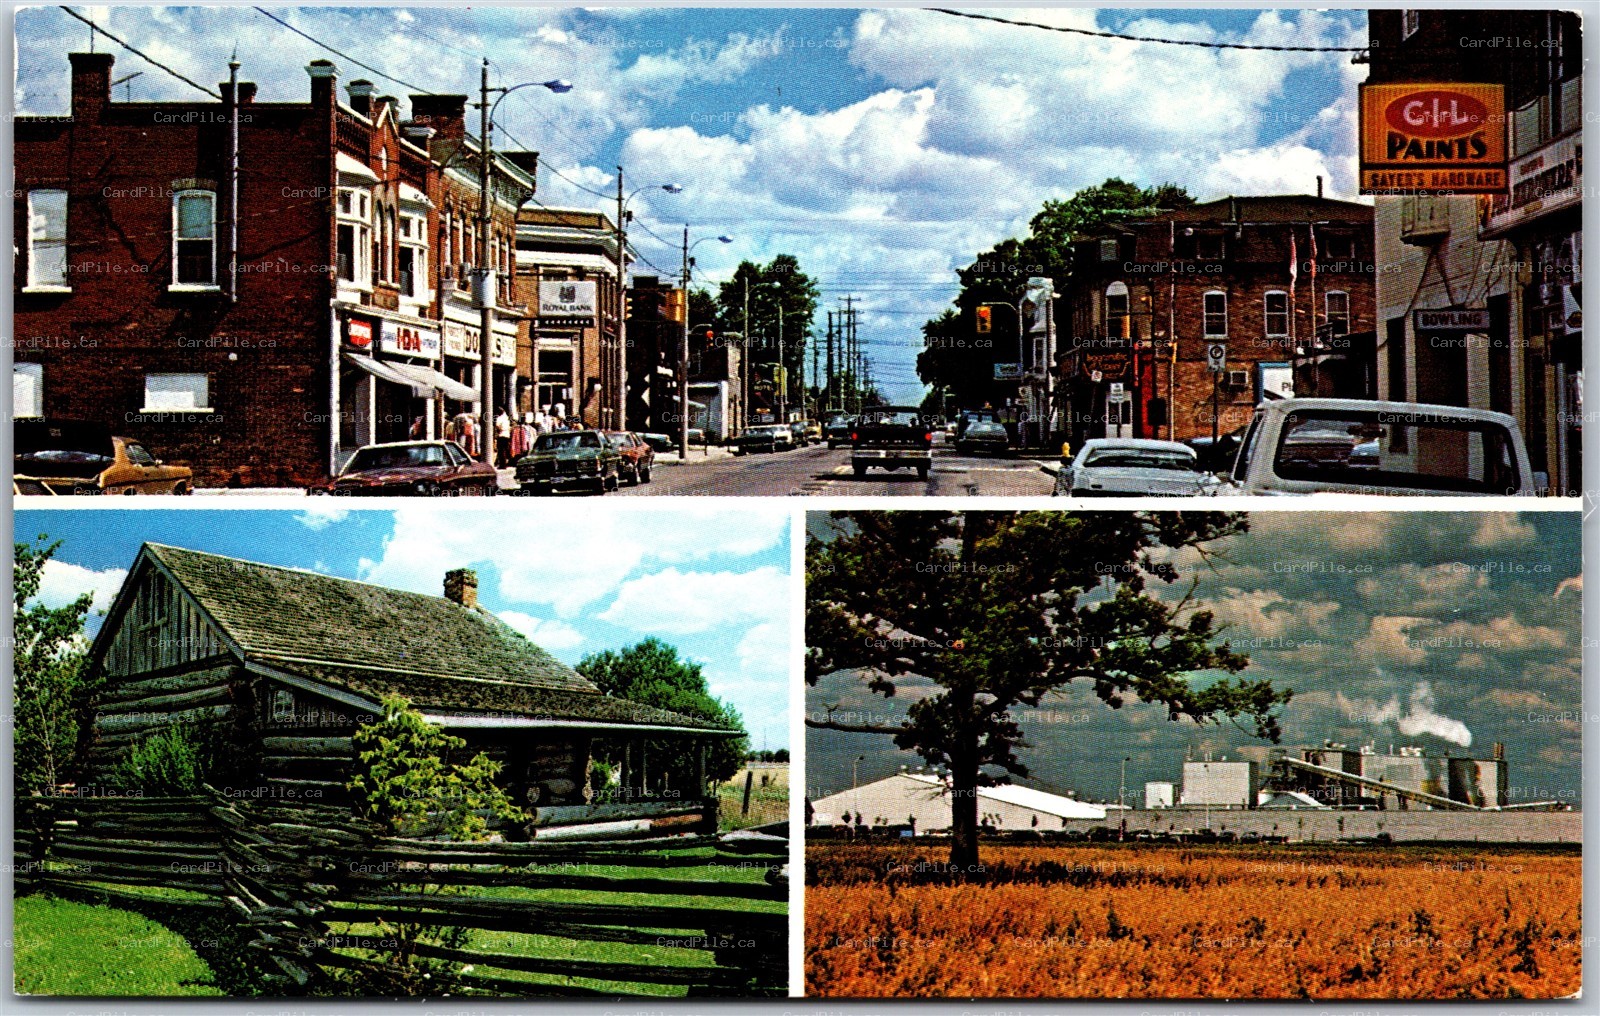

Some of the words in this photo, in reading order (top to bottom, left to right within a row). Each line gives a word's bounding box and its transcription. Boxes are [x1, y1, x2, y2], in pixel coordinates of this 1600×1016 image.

[1387, 131, 1488, 160] PAINTS
[1371, 173, 1425, 188] SAYER'S
[1431, 172, 1501, 187] HARDWARE
[543, 304, 567, 312] ROYAL
[1422, 313, 1483, 326] BOWLING
